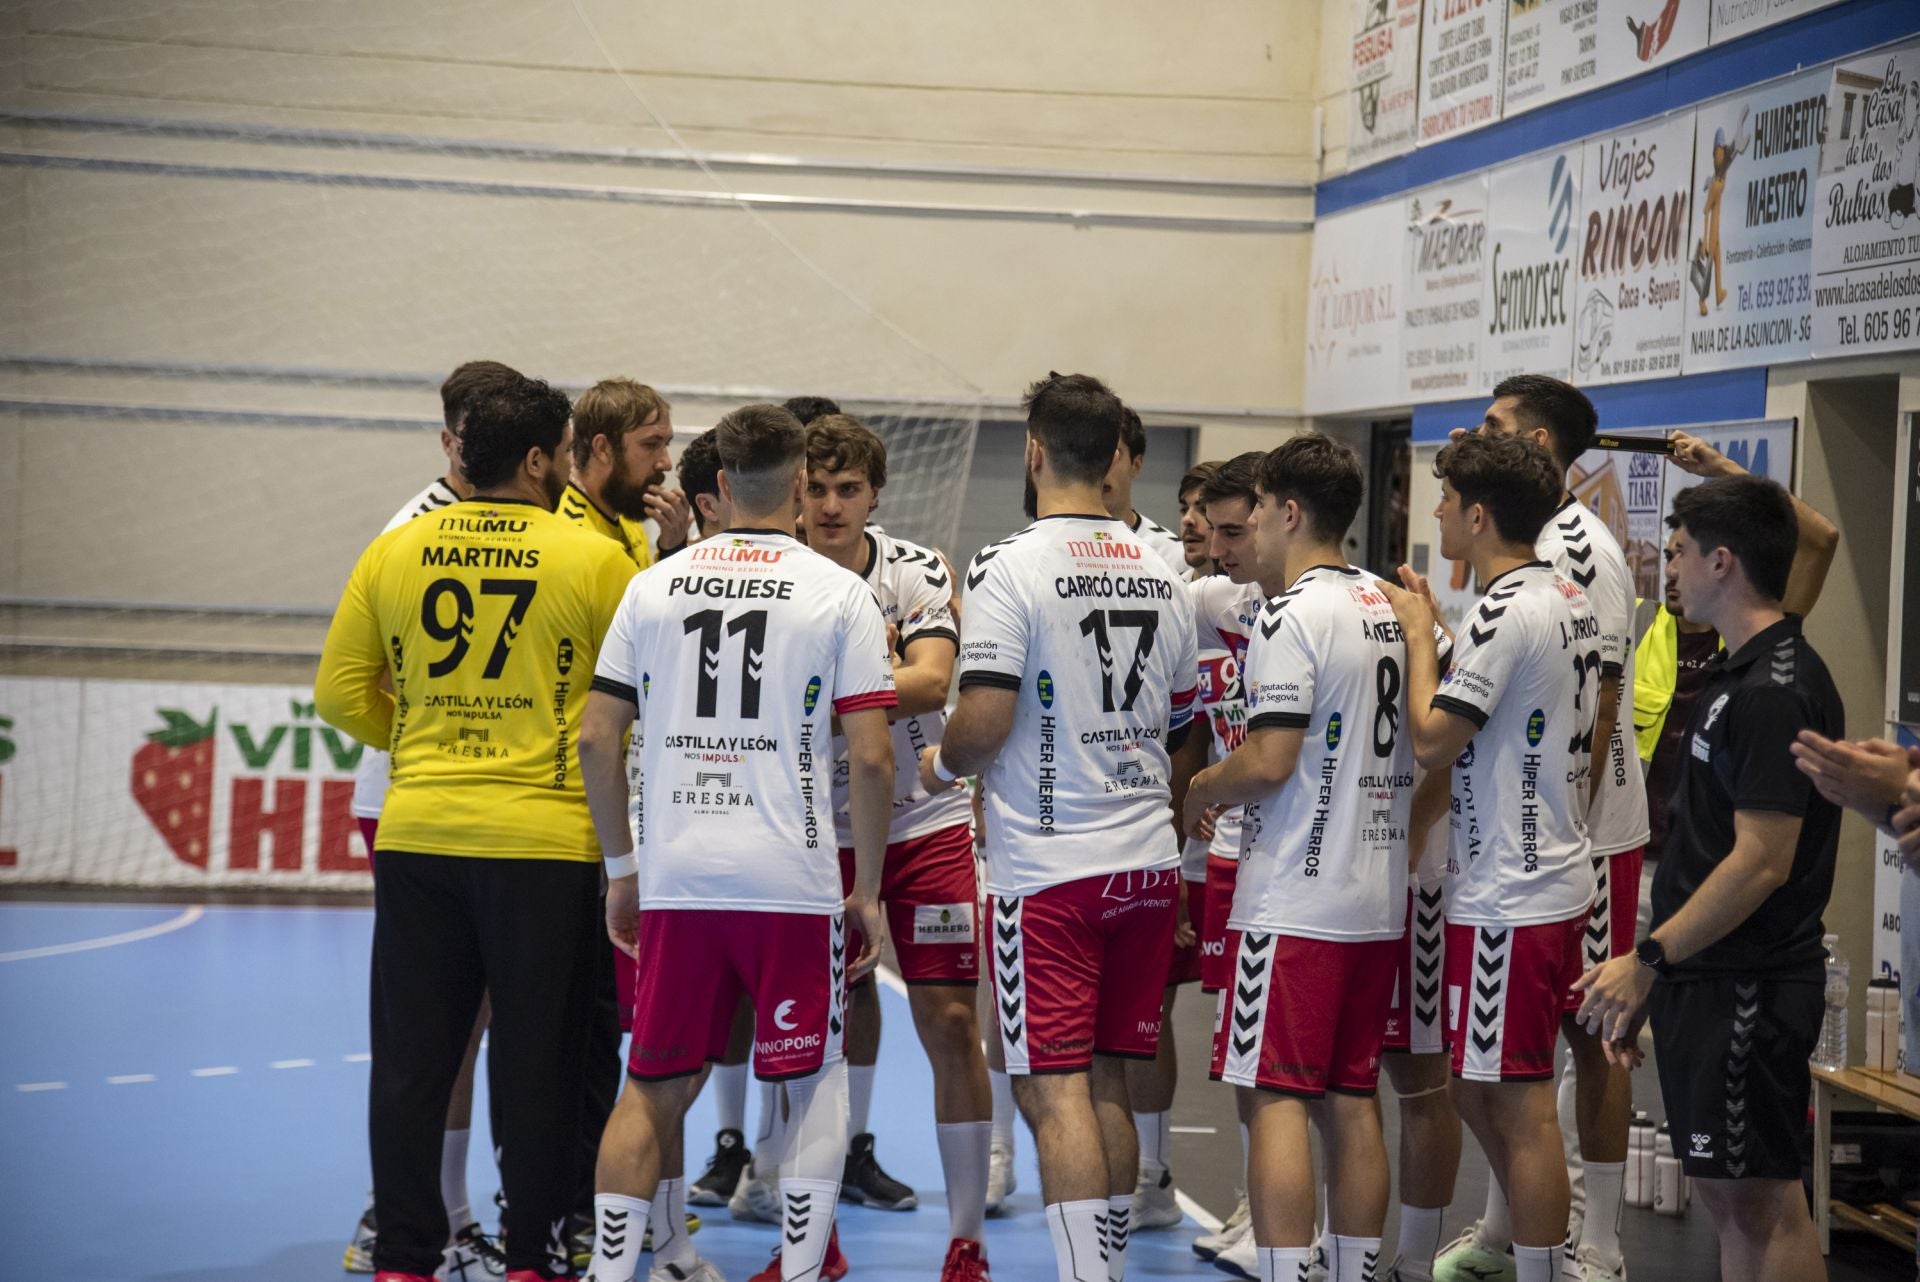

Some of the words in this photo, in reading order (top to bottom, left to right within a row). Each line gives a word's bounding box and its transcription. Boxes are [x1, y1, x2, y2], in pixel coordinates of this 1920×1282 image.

[1753, 94, 1829, 161] HUMBERTO
[1866, 91, 1902, 128] Casa
[1599, 138, 1657, 200] Viajes
[1872, 151, 1892, 184] dos
[1746, 168, 1808, 228] MAESTRO
[1826, 178, 1886, 229] Rubios
[1582, 189, 1687, 280] RINCON
[1843, 236, 1906, 265] ALOJAMIENTO
[1908, 234, 1920, 255] TU
[1490, 242, 1570, 336] Semorsec
[1618, 282, 1640, 311] Coca
[1648, 273, 1681, 312] Segovia
[1796, 272, 1811, 304] 39
[1690, 329, 1715, 356] NAVA
[1716, 327, 1730, 353] DE
[1730, 325, 1741, 351] LA
[1743, 317, 1793, 350] ASUNCION
[1838, 314, 1861, 346] Tel.
[1863, 311, 1890, 343] 605
[1893, 306, 1912, 339] 96
[1628, 480, 1658, 507] TIARA
[421, 546, 540, 568] MARTINS
[668, 576, 795, 600] PUGLIESE
[1115, 576, 1173, 601] CASTRO
[421, 578, 538, 679] 97
[1560, 621, 1573, 650] J.
[683, 609, 768, 719] 11
[967, 651, 998, 662] Segovia
[1079, 608, 1160, 713] 17
[424, 695, 483, 708] CASTILLA
[497, 693, 533, 709] LEÓN
[553, 681, 570, 726] HIPER
[1266, 692, 1300, 704] Segovia
[1374, 656, 1400, 758] 8
[665, 736, 727, 751] CASTILLA
[740, 734, 778, 752] LEÓN
[799, 723, 814, 773] HIPER
[1040, 715, 1056, 763] HIPER
[1081, 727, 1131, 745] CASTILA
[552, 729, 569, 790] HIERROS
[684, 752, 700, 760] NOS
[702, 753, 746, 765] IMPULSA
[1522, 753, 1541, 800] HIPER
[672, 790, 754, 806] ERESMA
[1038, 767, 1057, 832] HIERROS
[1318, 757, 1338, 805] HIPER
[801, 777, 818, 849] HIERROS
[1304, 808, 1330, 877] HIERROS
[1362, 827, 1406, 842] ERESMA
[1522, 804, 1539, 873] HIERROS
[919, 924, 970, 934] HERRERO
[757, 1034, 820, 1055] NNOPORC
